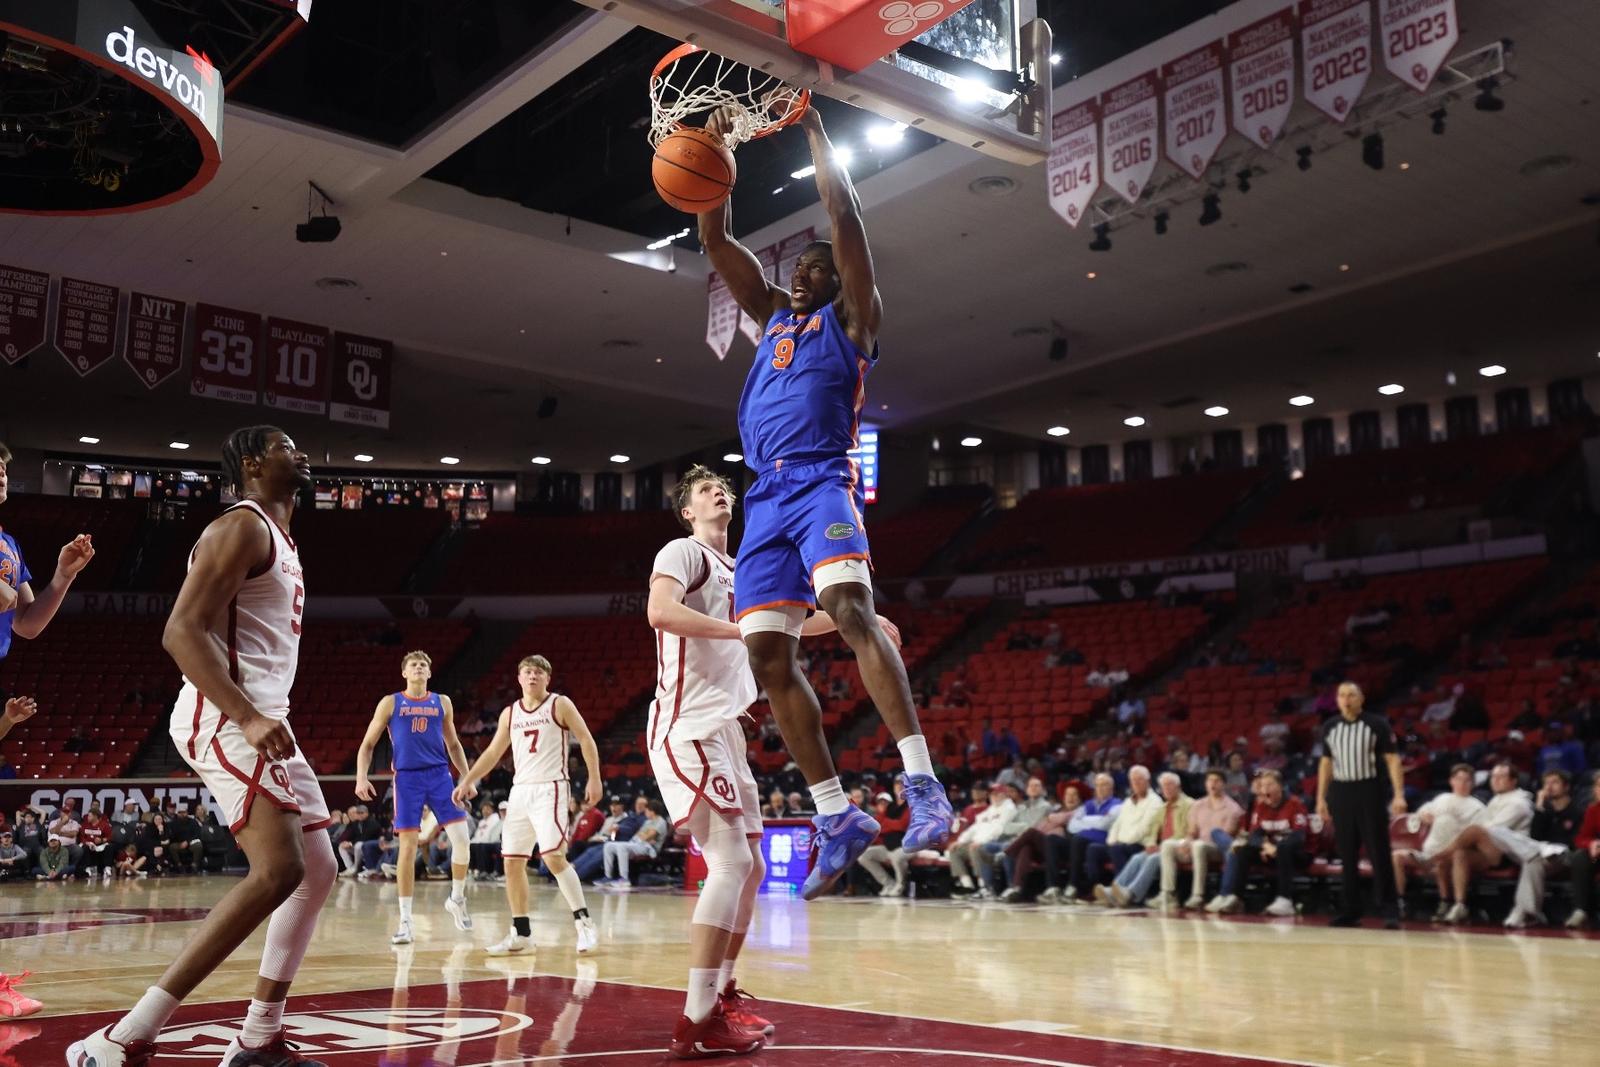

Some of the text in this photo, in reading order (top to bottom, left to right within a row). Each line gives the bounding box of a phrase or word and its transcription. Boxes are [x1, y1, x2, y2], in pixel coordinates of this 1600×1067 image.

[1389, 11, 1448, 58] 2023
[105, 25, 207, 121] devon
[1312, 45, 1366, 92] 2022
[1242, 78, 1288, 119] 2019
[1176, 108, 1216, 147] 2017
[1113, 137, 1152, 173] 2016
[1052, 161, 1091, 197] 2014
[140, 297, 176, 320] NIT
[214, 315, 245, 332] KING
[200, 329, 253, 377] 33
[271, 327, 326, 347] BLAYLOCK
[345, 341, 383, 360] TUBBS
[771, 338, 795, 370] 9
[275, 343, 317, 387] 10
[347, 359, 378, 400] OU
[399, 706, 439, 717] FLORIDA
[412, 717, 428, 733] 10
[513, 718, 550, 730] OKLAHOMA
[524, 729, 539, 753] 7
[711, 776, 736, 802] OU
